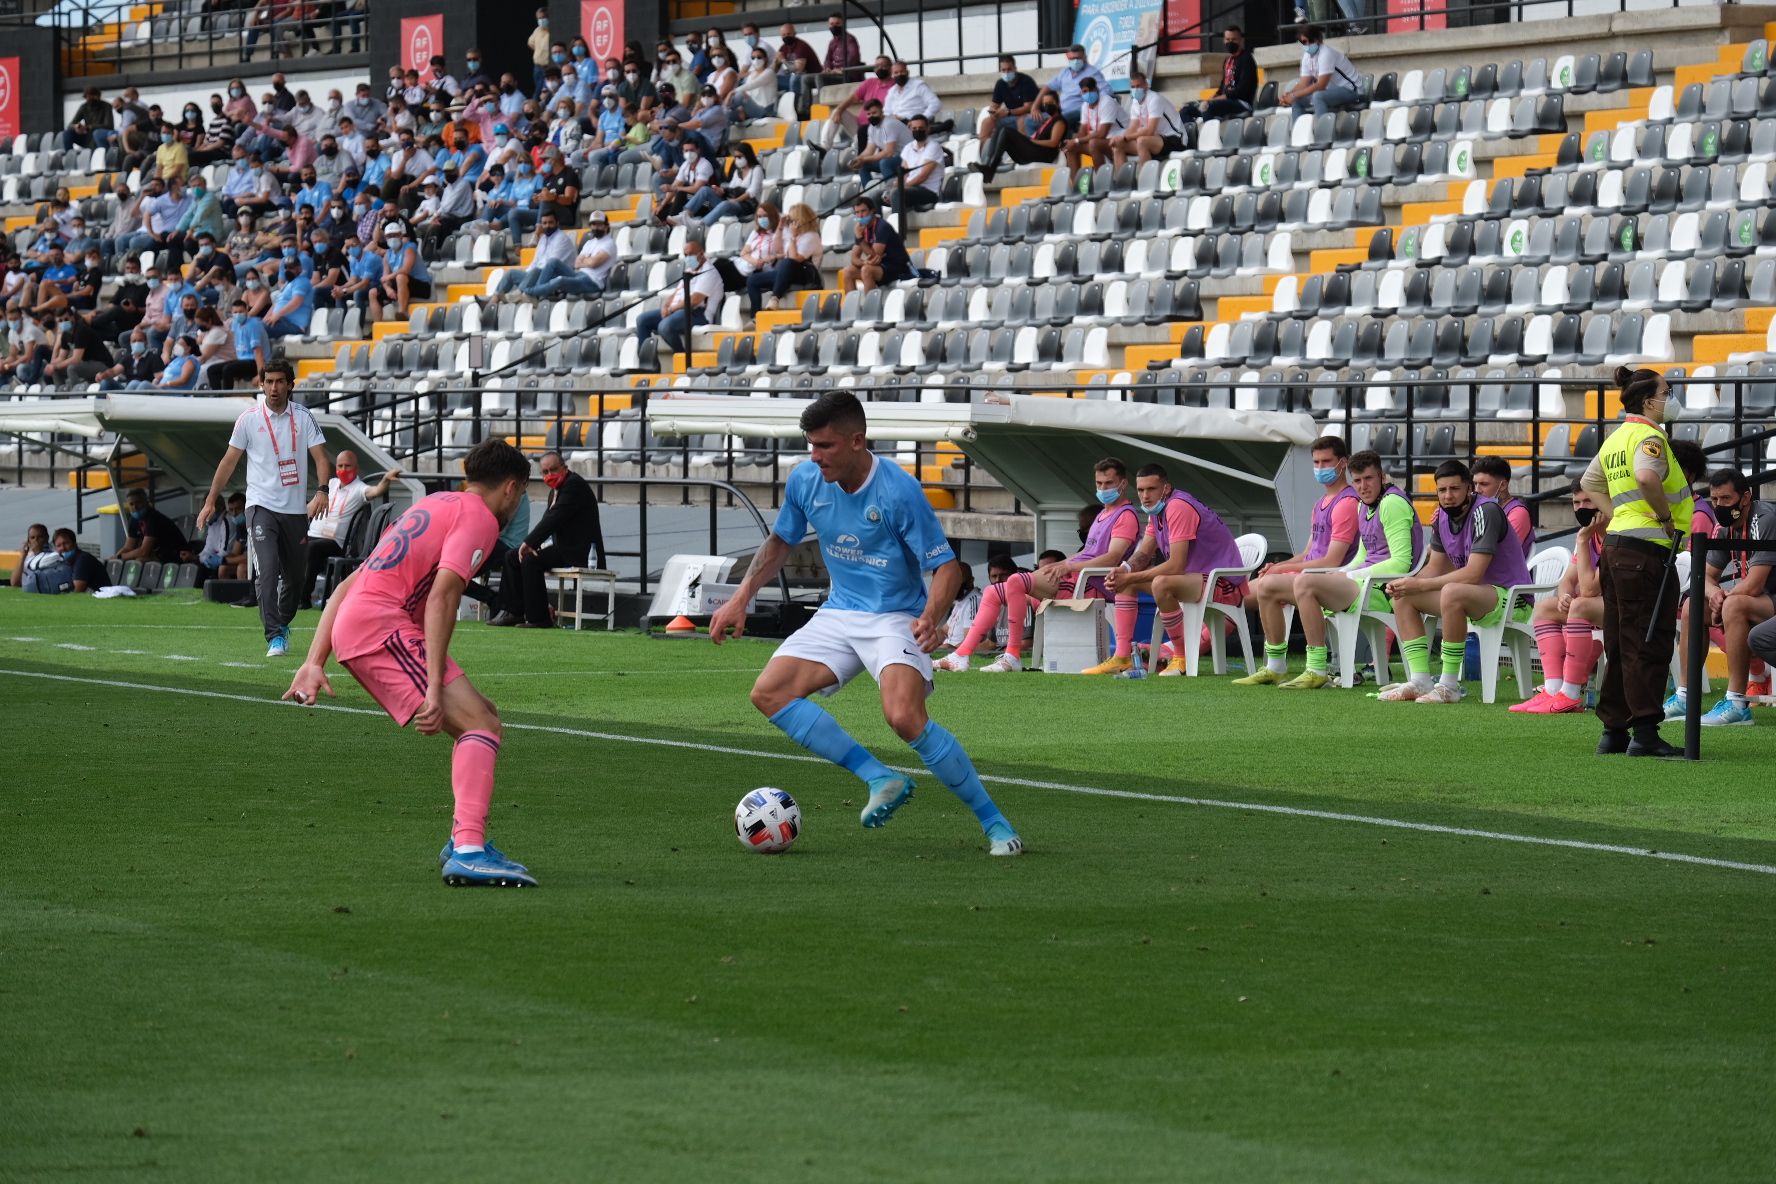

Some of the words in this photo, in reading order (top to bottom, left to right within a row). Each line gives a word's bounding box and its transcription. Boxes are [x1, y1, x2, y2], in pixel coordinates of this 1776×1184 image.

[595, 20, 609, 31] RF
[415, 37, 428, 48] RF
[595, 35, 609, 47] EF
[415, 51, 428, 63] EF
[829, 544, 864, 556] POWER
[825, 547, 888, 567] ELECTRONICS
